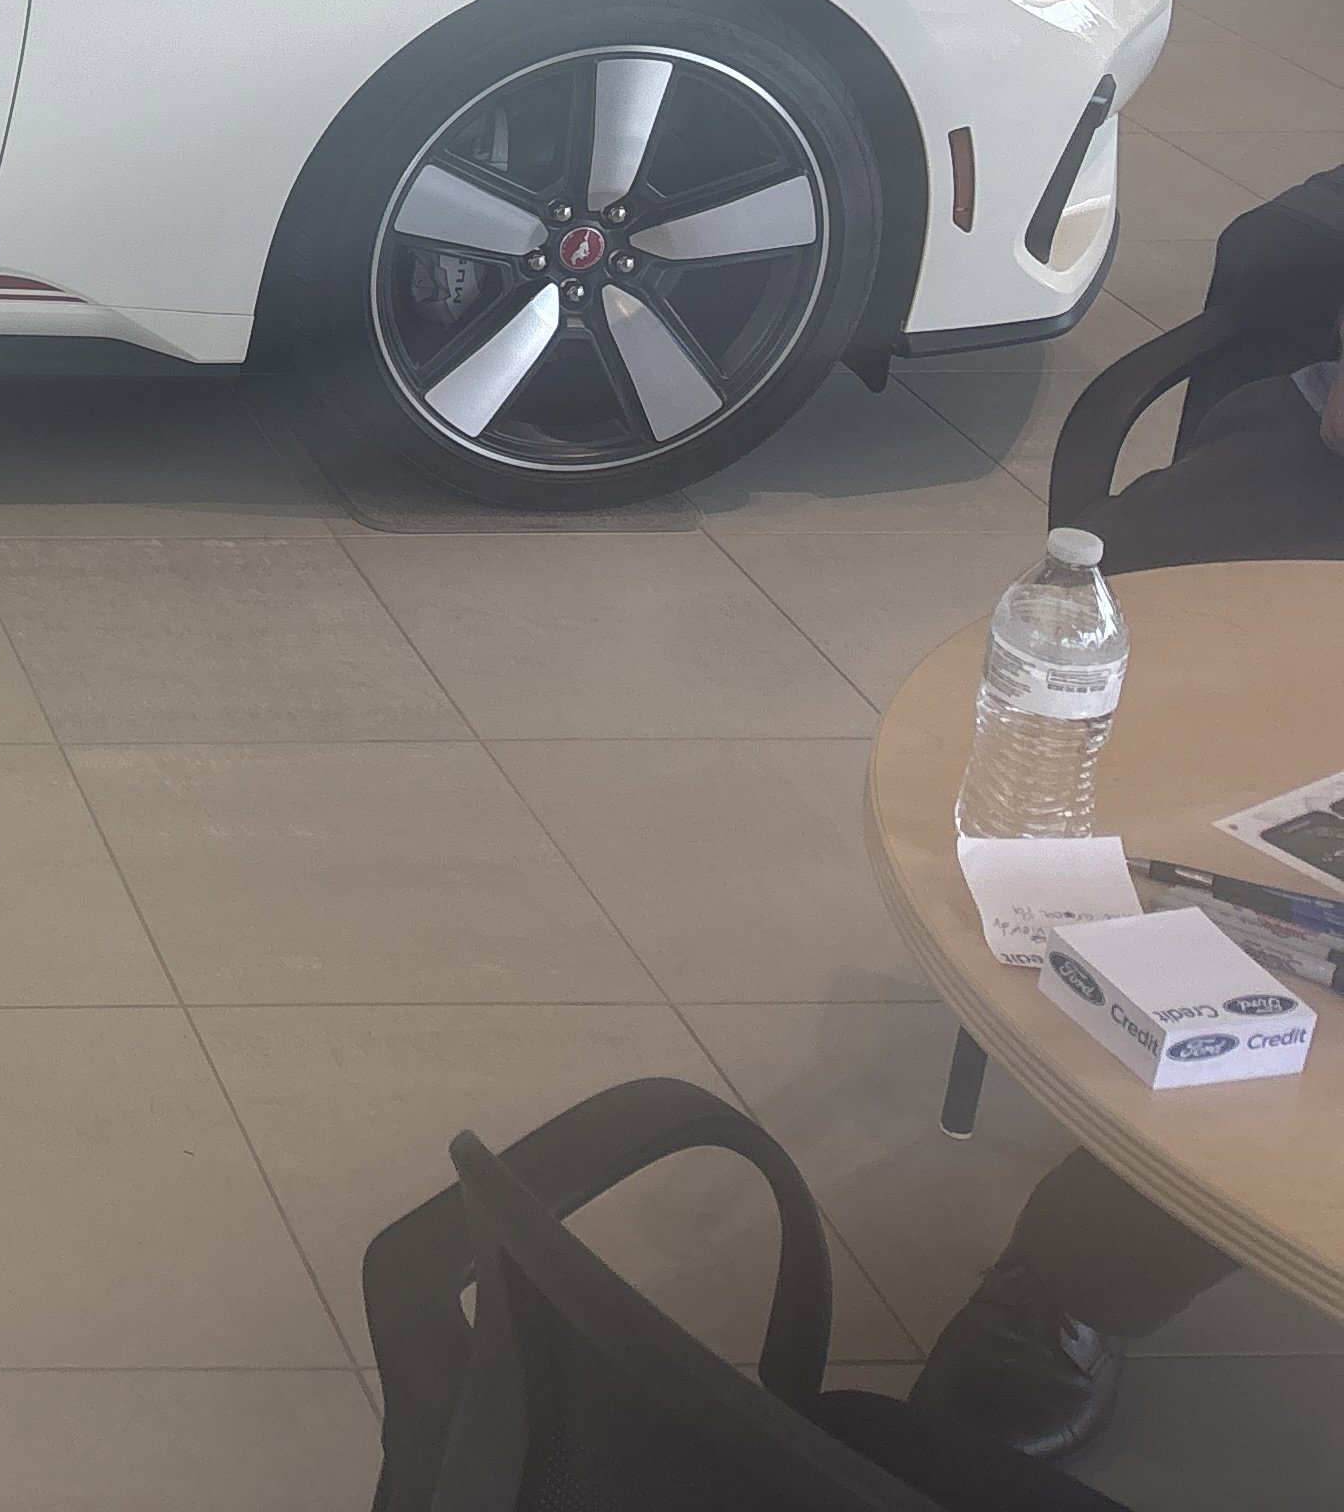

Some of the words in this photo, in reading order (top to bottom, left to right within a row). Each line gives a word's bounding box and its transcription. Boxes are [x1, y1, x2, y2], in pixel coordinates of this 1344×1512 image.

[1152, 1005, 1220, 1024] Credit
[1110, 1002, 1160, 1057] Credit
[1246, 1026, 1308, 1050] Credit
